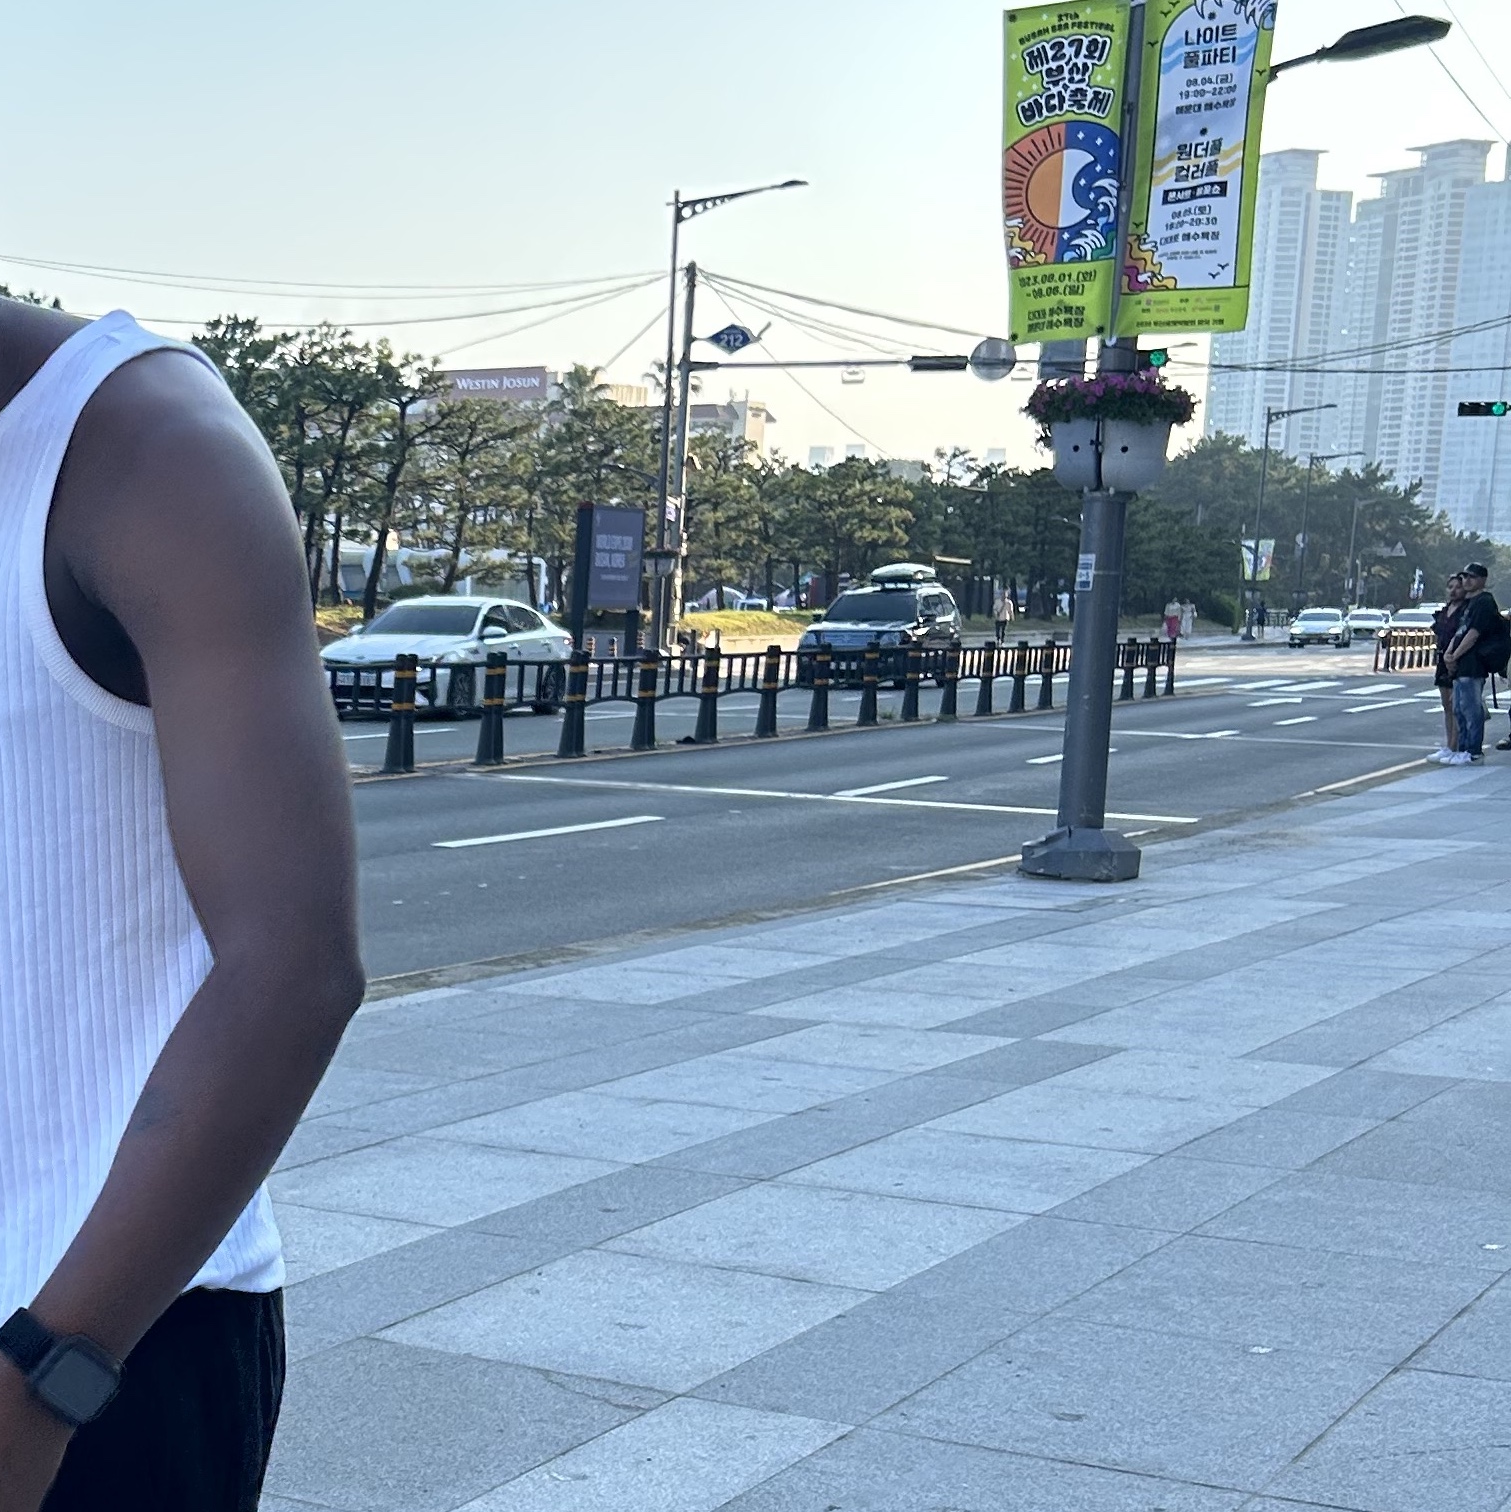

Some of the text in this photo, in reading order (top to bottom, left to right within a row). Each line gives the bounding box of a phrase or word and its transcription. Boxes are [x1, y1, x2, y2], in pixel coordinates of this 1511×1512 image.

[1184, 24, 1238, 46] 나이트
[1025, 37, 1108, 71] 제27회
[1183, 45, 1237, 69] 풀파티
[1045, 61, 1090, 88] 부산
[1020, 87, 1111, 122] 바다축제
[720, 333, 744, 347] 212
[455, 375, 541, 390] WESTIN JOSUN
